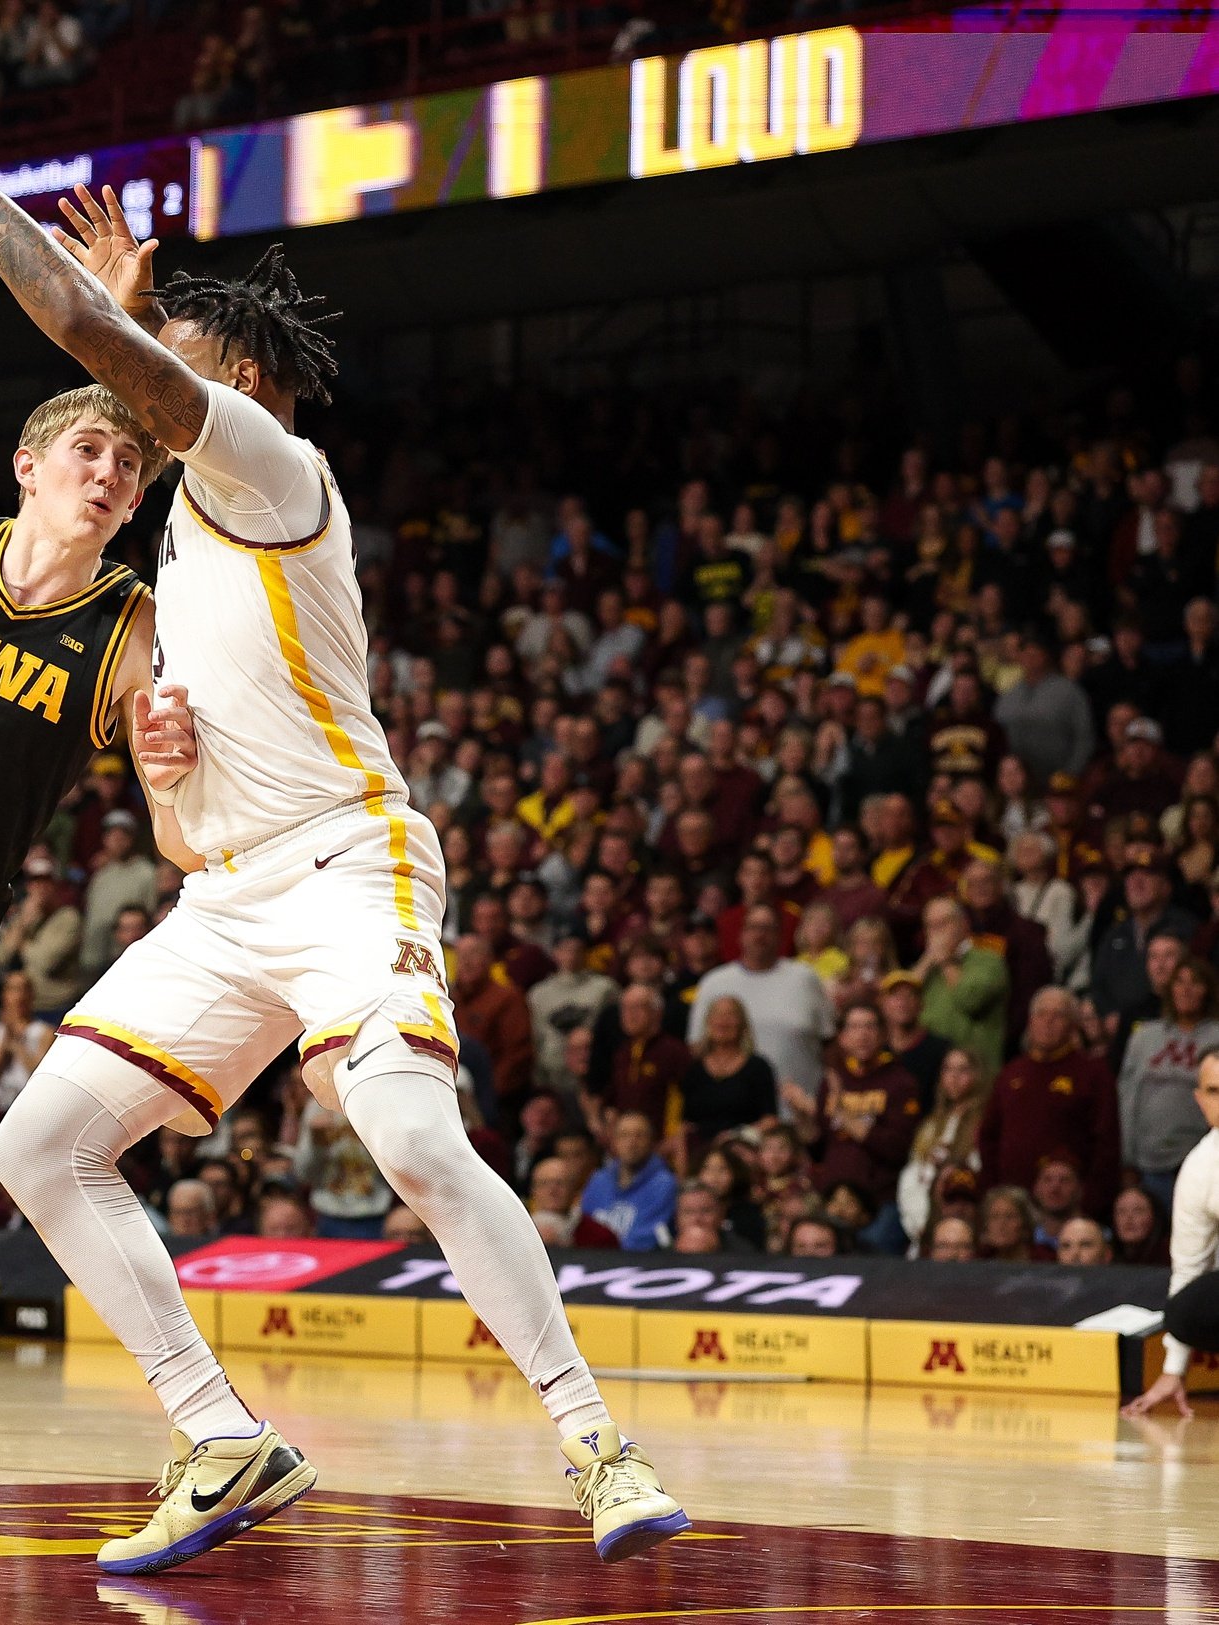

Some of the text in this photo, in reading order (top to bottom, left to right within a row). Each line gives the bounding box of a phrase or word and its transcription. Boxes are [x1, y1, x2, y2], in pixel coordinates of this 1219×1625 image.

[629, 25, 864, 180] LOUD
[382, 1258, 863, 1308] TYOTA
[972, 1340, 1053, 1364] HEALTH
